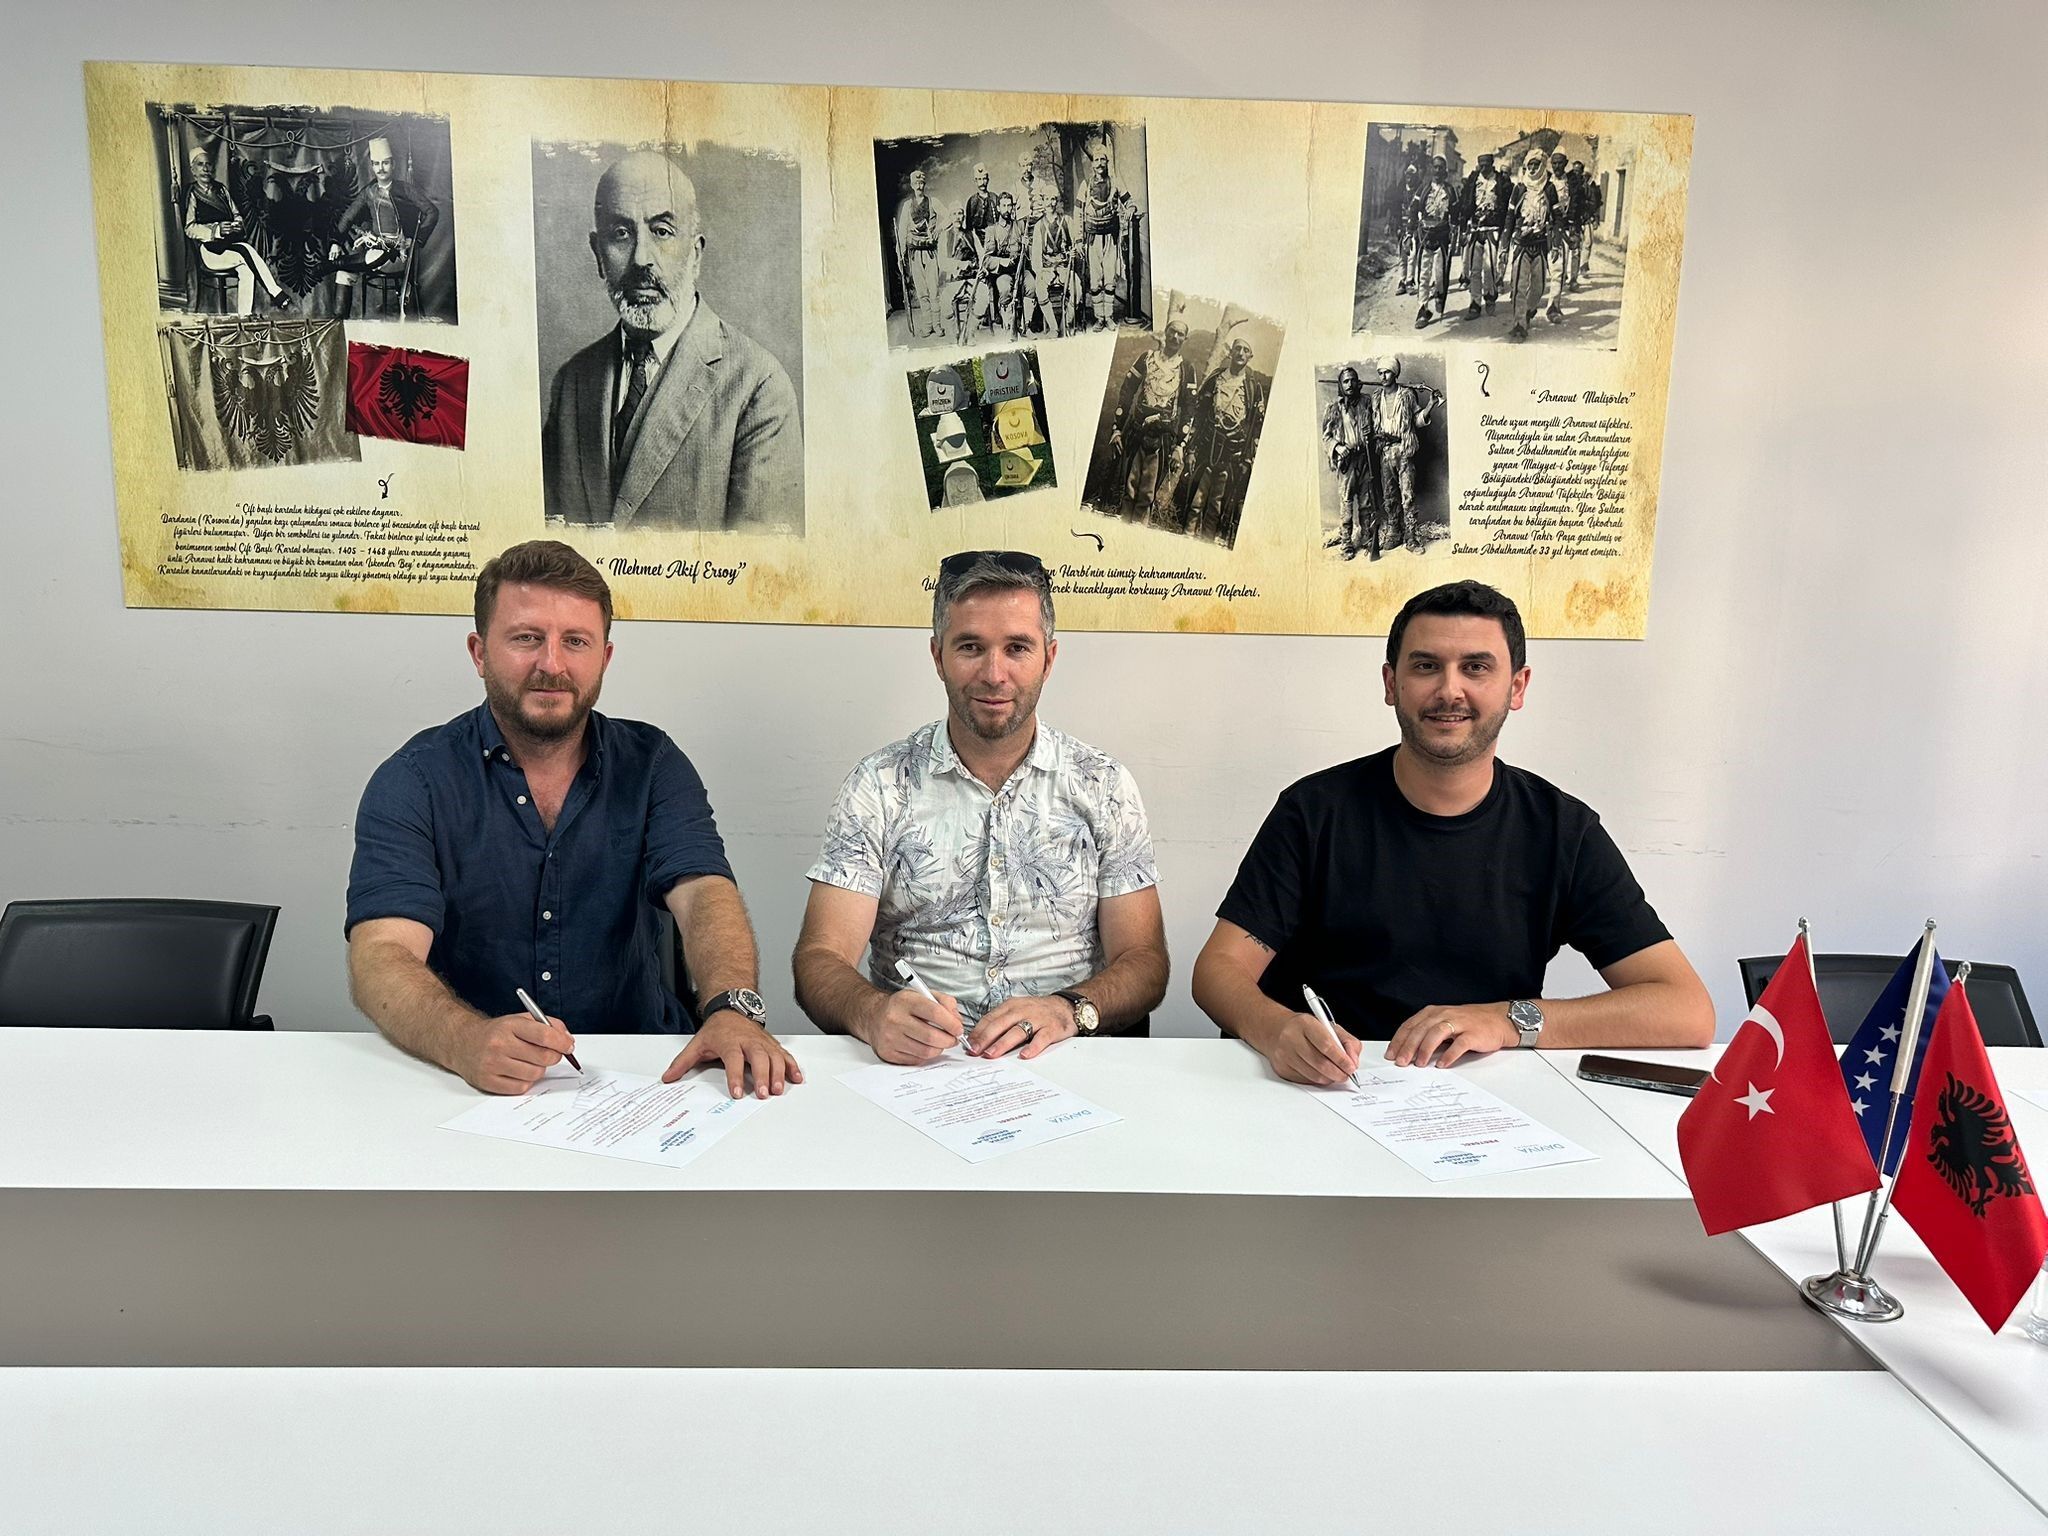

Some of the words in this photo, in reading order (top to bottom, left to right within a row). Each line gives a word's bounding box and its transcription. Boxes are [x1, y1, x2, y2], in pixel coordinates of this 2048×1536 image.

[1537, 390, 1577, 404] Arnavut
[1480, 415, 1508, 427] Ellerde
[1509, 419, 1528, 431] uzun
[1530, 416, 1561, 431] menzilli
[1562, 417, 1597, 429] Arnavut
[1598, 417, 1633, 432] tüfekleri.
[1005, 431, 1028, 441] KOSOVA
[1542, 433, 1553, 442] ün
[1555, 431, 1576, 442] salan
[1577, 431, 1632, 444] Arnavutların
[1487, 444, 1515, 456] Sultan
[1492, 462, 1519, 473] yapan
[1565, 459, 1597, 475] Seniyye
[1600, 458, 1629, 476] Tüfengi
[1584, 473, 1618, 489] vazifeleri
[1518, 487, 1554, 499] Arnavut
[1556, 488, 1594, 503] Tüfekçiler
[1596, 488, 1626, 503] Bölüğü
[242, 503, 256, 515] Çift
[332, 506, 345, 517] çok
[346, 507, 371, 516] eskilere
[371, 507, 403, 519] dayanır.
[1458, 501, 1485, 511] olarak
[1486, 501, 1527, 512] anılmasını
[1575, 502, 1596, 517] Yine
[1598, 502, 1625, 514] Sultan
[161, 513, 197, 525] Dardania
[245, 516, 272, 529] yapılan
[274, 516, 289, 529] kazı
[329, 520, 352, 528] sonucu
[354, 518, 380, 529] binlerce
[380, 520, 391, 532] yıl
[428, 520, 440, 533] çift
[458, 521, 480, 531] kartal
[1469, 515, 1511, 529] tarafından
[1513, 516, 1523, 526] bu
[1525, 515, 1557, 530] bölüğün
[1559, 516, 1584, 529] başına
[275, 529, 286, 538] bir
[287, 528, 320, 539] sembolleri
[387, 531, 414, 542] binlerce
[414, 531, 424, 545] yıl
[426, 532, 446, 543] içinde
[447, 535, 455, 543] en
[456, 533, 469, 544] çok
[1492, 529, 1529, 542] Arnavut
[1530, 530, 1553, 542] Tahir
[1556, 530, 1576, 543] Paşa
[1614, 535, 1622, 543] ve
[214, 542, 237, 552] sembol
[238, 542, 252, 556] Çift
[274, 543, 301, 554] Kartal
[338, 547, 357, 555] 1405
[367, 547, 386, 555] 1468
[411, 548, 442, 557] arasında
[1452, 543, 1478, 555] Sultan
[1539, 546, 1550, 555] 33
[1551, 545, 1563, 560] yıl
[1564, 545, 1589, 560] hizmet
[184, 554, 215, 564] Arnavut
[216, 554, 233, 563] halk
[234, 555, 272, 565] kahramanı
[282, 556, 304, 569] büyük
[305, 556, 316, 566] bir
[317, 557, 347, 567] komutan
[348, 558, 363, 567] olan
[244, 569, 251, 577] ve
[418, 572, 428, 584] yıl
[608, 557, 664, 577] Mehmet
[665, 560, 701, 584] Akif
[1107, 566, 1137, 584] isimsiz
[1139, 566, 1207, 581] kahramanları.
[1073, 580, 1127, 600] kucaklayan
[1128, 580, 1170, 601] korkusuz
[1170, 582, 1213, 598] Arnavut
[1215, 583, 1260, 602] Neferleri.
